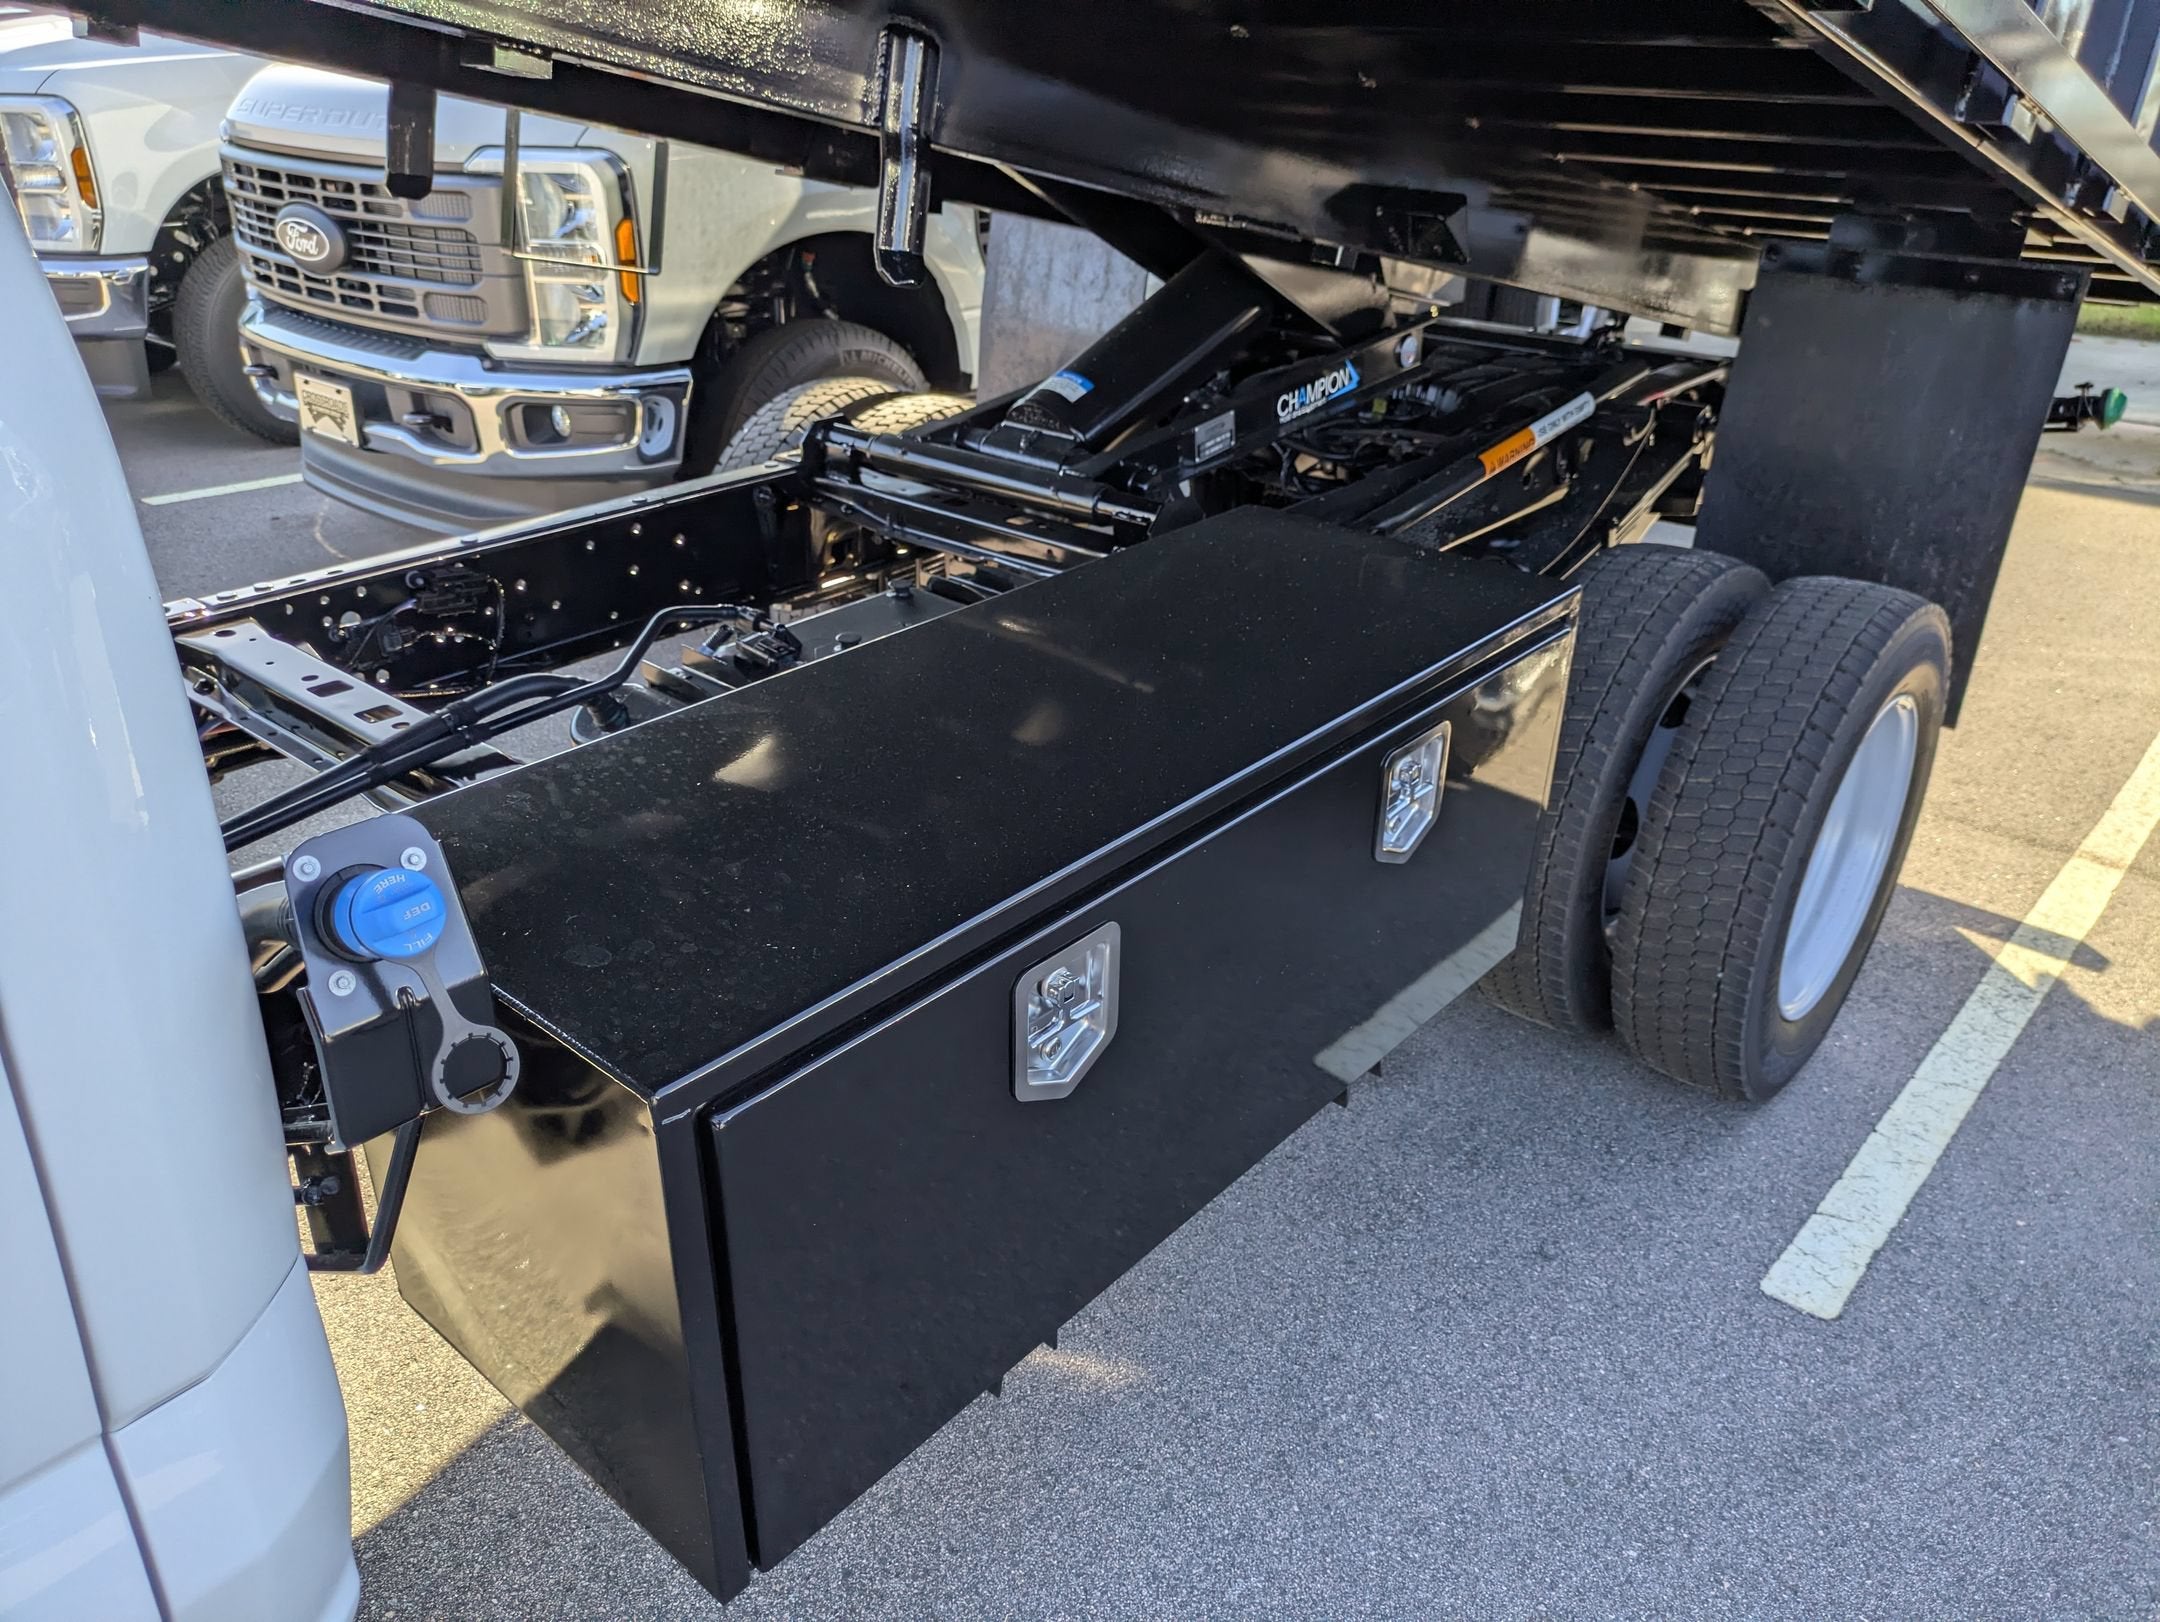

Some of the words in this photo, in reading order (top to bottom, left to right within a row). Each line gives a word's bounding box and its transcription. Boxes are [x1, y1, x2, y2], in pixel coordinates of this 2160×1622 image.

[236, 98, 323, 124] SUPER
[324, 106, 388, 132] DUT
[286, 222, 319, 256] Ford
[1277, 367, 1350, 417] CHAMPION
[1496, 438, 1536, 467] WARNING
[373, 873, 406, 895] HERE
[403, 902, 431, 920] DEF
[404, 932, 433, 952] FILL
